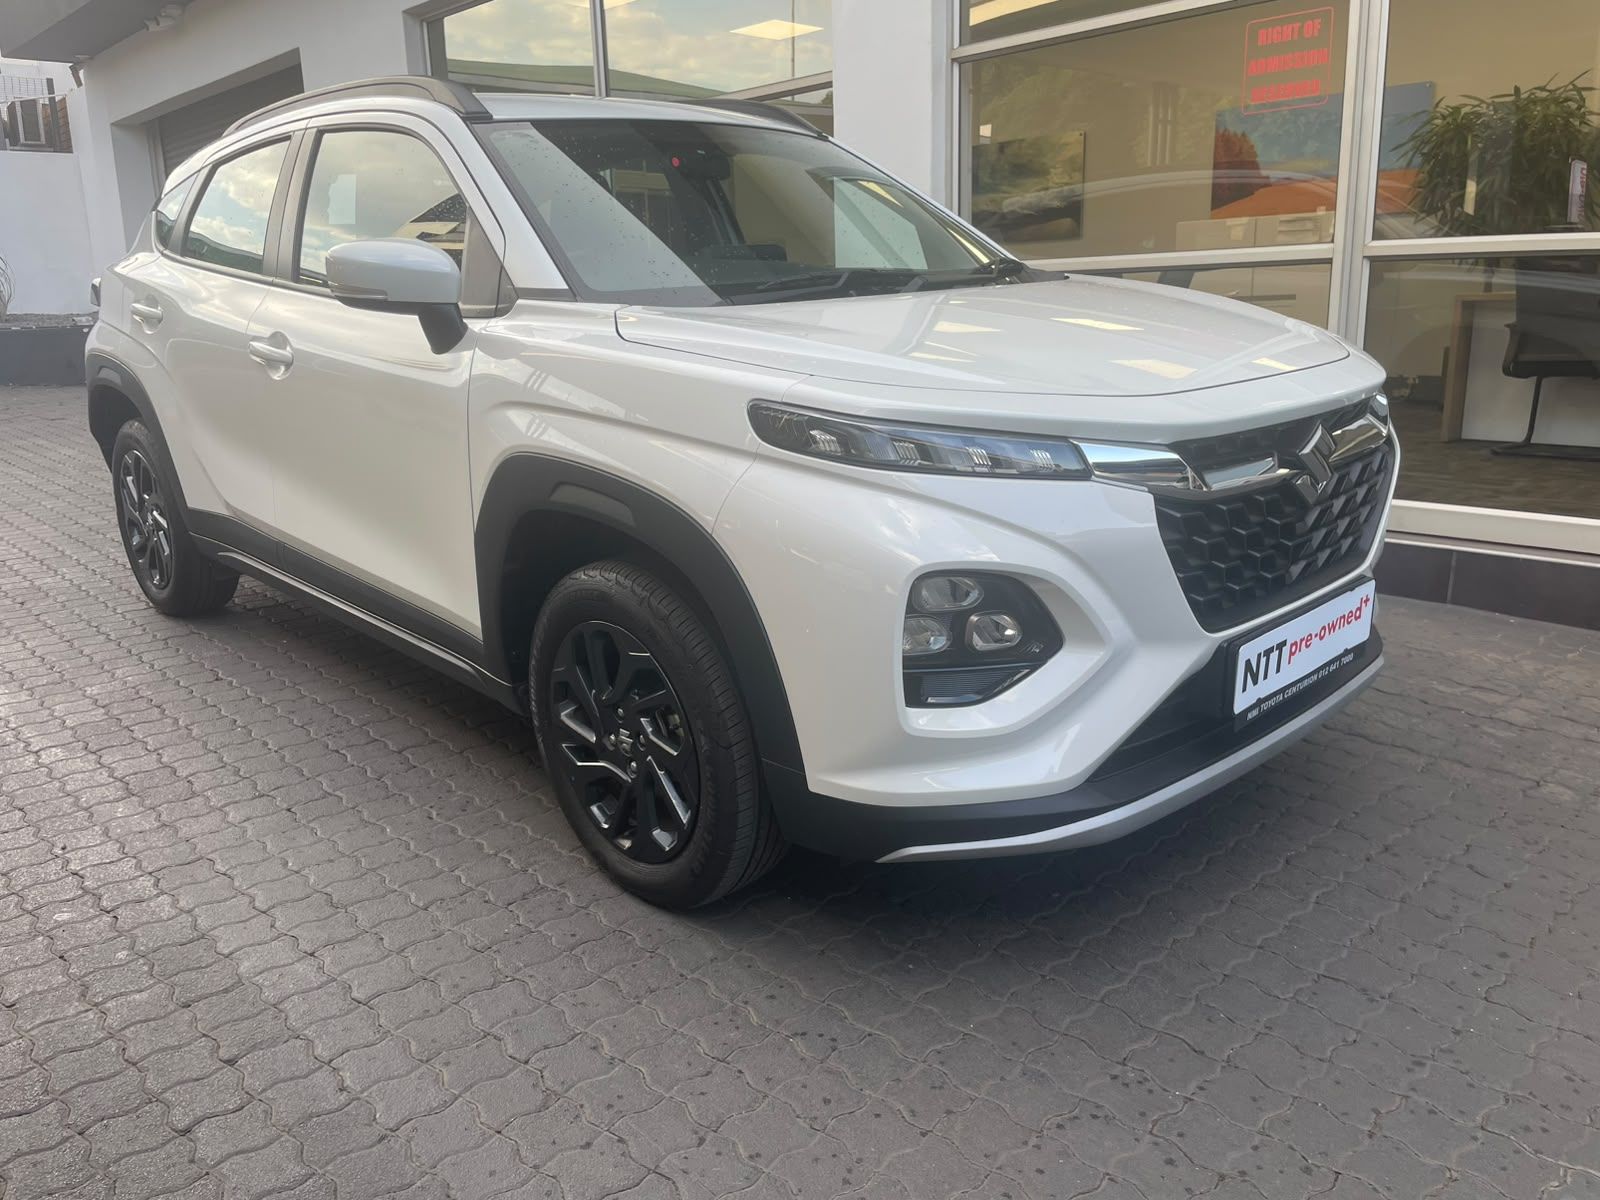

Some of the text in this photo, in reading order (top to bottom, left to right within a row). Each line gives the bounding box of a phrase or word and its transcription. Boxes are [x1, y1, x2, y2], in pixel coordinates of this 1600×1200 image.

[1303, 18, 1321, 38] OF
[1242, 639, 1287, 693] NTT
[1260, 693, 1283, 712] TOYOTA
[1284, 674, 1318, 697] CENTURION
[1318, 667, 1329, 679] 012
